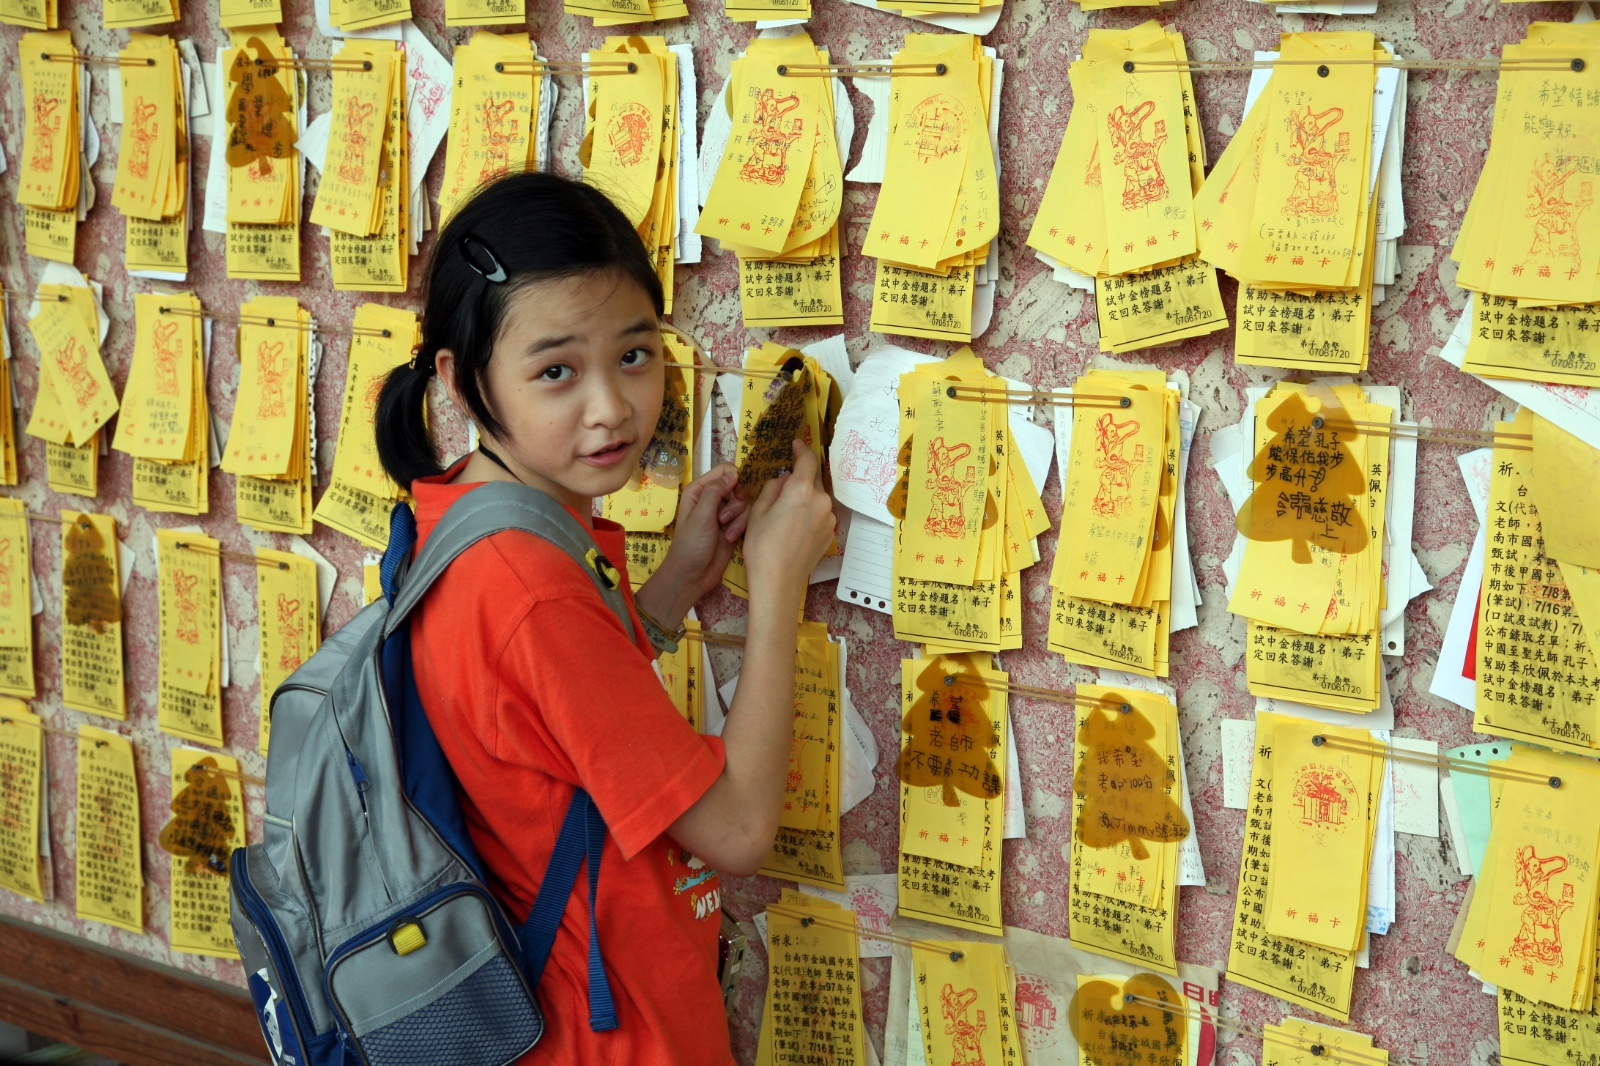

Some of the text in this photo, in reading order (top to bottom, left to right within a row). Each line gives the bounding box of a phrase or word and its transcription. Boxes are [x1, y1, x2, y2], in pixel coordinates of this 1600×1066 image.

[718, 217, 772, 235] 祈福卡
[880, 231, 929, 249] 祈福卡
[1048, 226, 1094, 254] 祈福卡
[1123, 229, 1180, 253] 祈福卡
[1265, 253, 1331, 268] 祈福卡
[1512, 264, 1577, 280] 祈福卡
[746, 286, 801, 298] 定回來答謝。
[880, 292, 934, 306] 定回來答謝。
[1108, 298, 1172, 322] 定回來答謝。
[1243, 320, 1311, 335] 定回來答謝。
[1479, 327, 1556, 344] 定回來答謝。
[1283, 425, 1341, 450] 希望孔子
[1268, 445, 1345, 471] 能保佑我步
[1498, 461, 1520, 477] 祈
[1517, 484, 1528, 497] 台
[624, 507, 665, 517] 祈福卡
[915, 552, 963, 567] 祈福卡
[1080, 570, 1125, 585] 祈福卡
[897, 602, 956, 617] 定回來答謝。
[1250, 589, 1310, 614] 祈福卡
[1056, 613, 1112, 635] 定回來答謝。
[1485, 626, 1593, 656] 公布錄取名單；祈
[1254, 649, 1323, 669] 定回來答謝。
[1483, 656, 1600, 692] 幫助李欣佩於本次考
[1483, 689, 1553, 711] 定回來答謝。
[929, 726, 973, 752] 老師
[1258, 745, 1272, 760] 祈
[919, 829, 968, 846] 祈福卡
[902, 879, 958, 897] 定回來答謝。
[1072, 911, 1129, 934] 定回來答謝。
[1286, 908, 1341, 929] 祈福卡
[1235, 941, 1301, 970] 定回來答謝。
[1499, 956, 1558, 983] 祈福卡
[1504, 1021, 1576, 1044] 定回來答謝。
